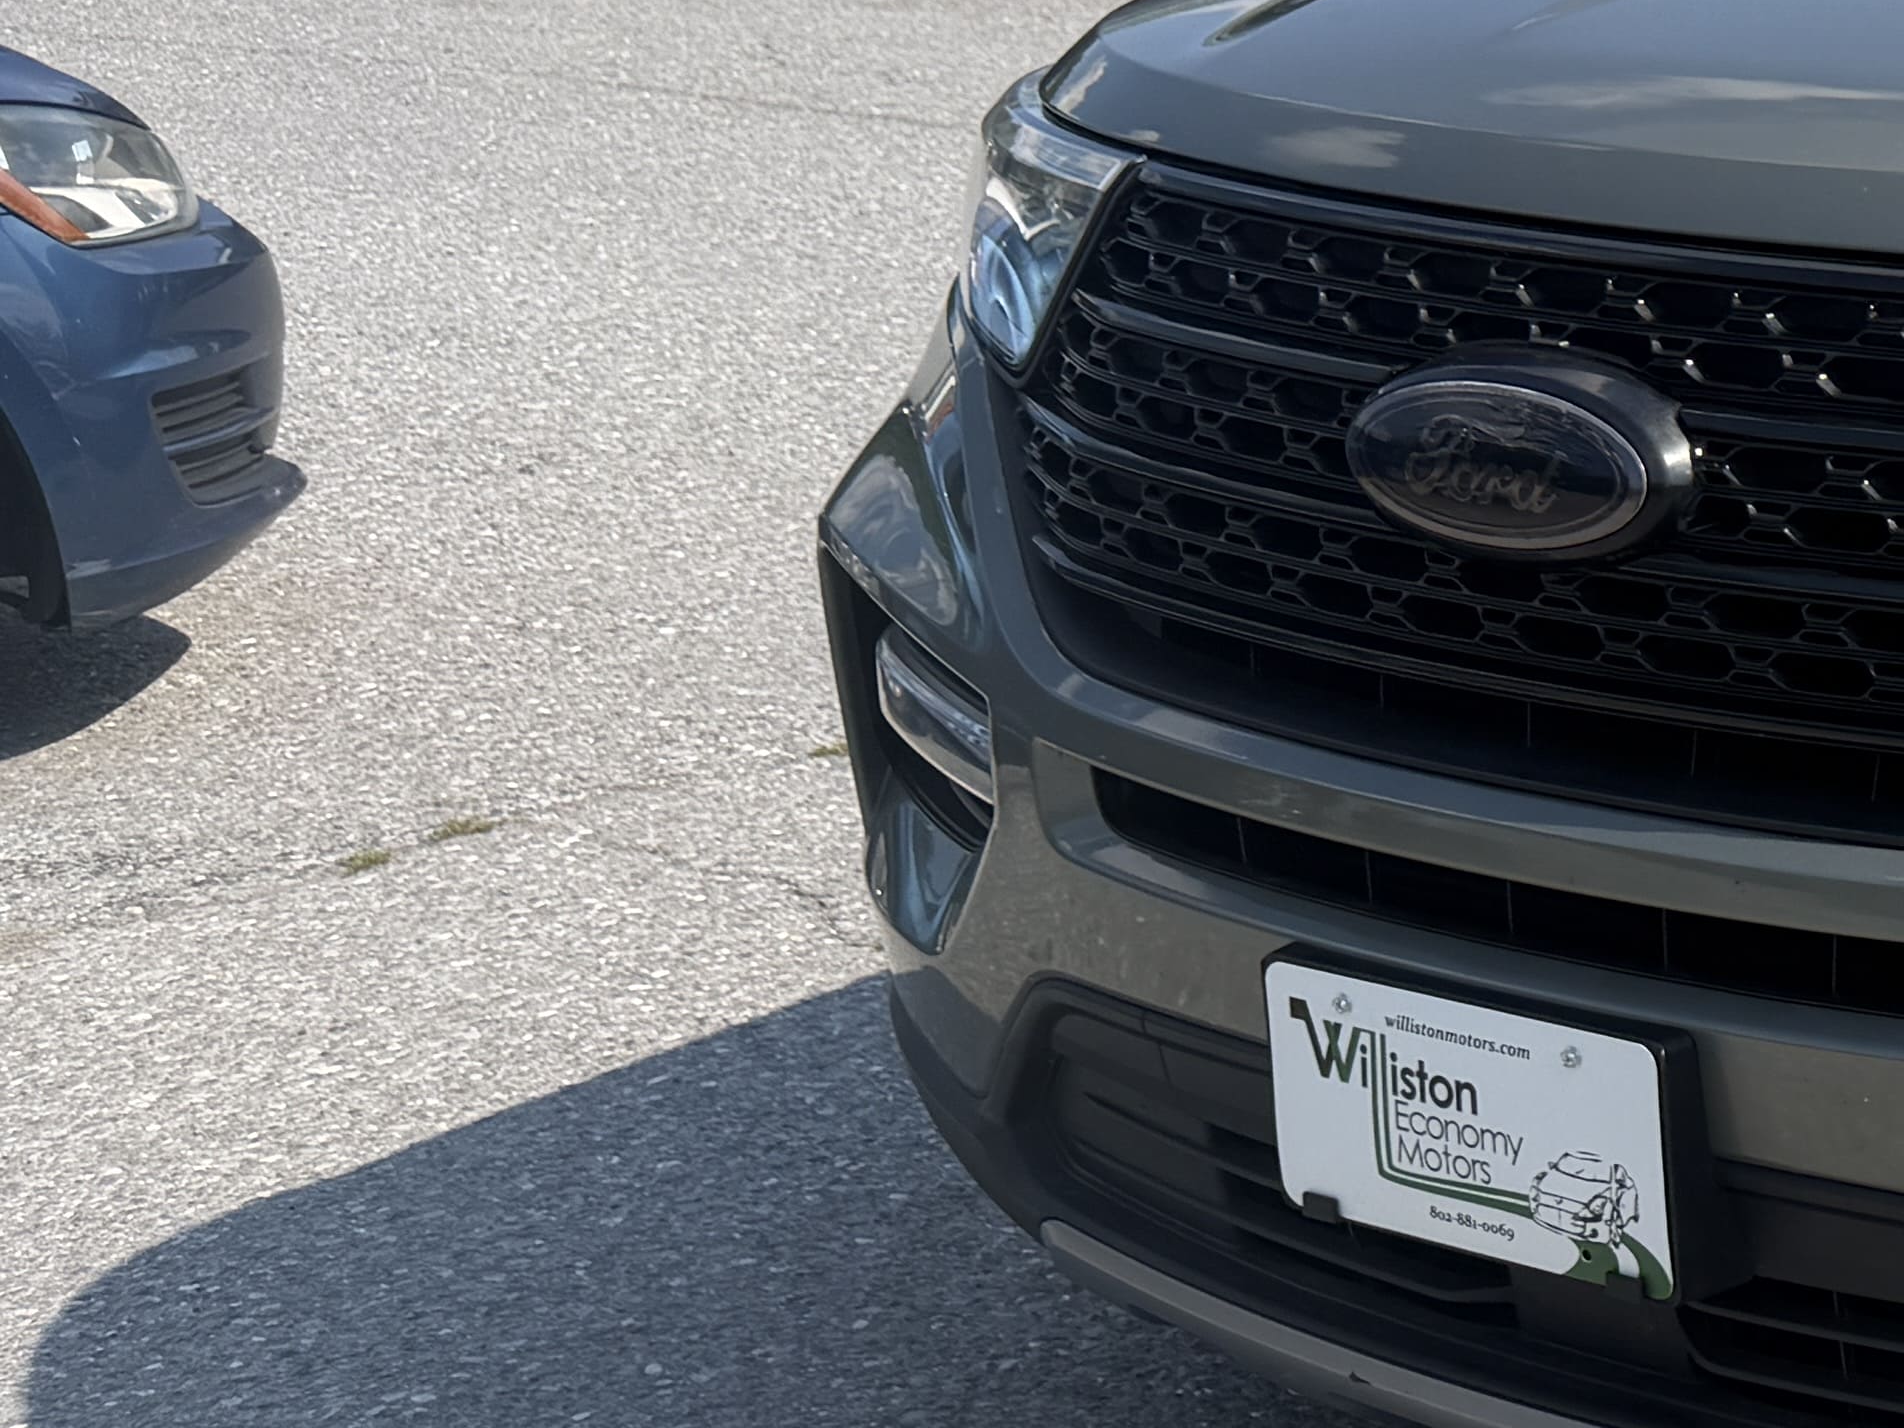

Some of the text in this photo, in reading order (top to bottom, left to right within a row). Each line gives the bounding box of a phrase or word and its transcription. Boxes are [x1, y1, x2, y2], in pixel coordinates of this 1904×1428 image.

[1405, 414, 1563, 513] Ford
[1289, 996, 1480, 1116] Williston
[1385, 1014, 1530, 1060] willistonmotors.com
[1395, 1100, 1524, 1166] Economy
[1397, 1134, 1492, 1185] Motors
[1429, 1205, 1516, 1242] 802-881-0069
